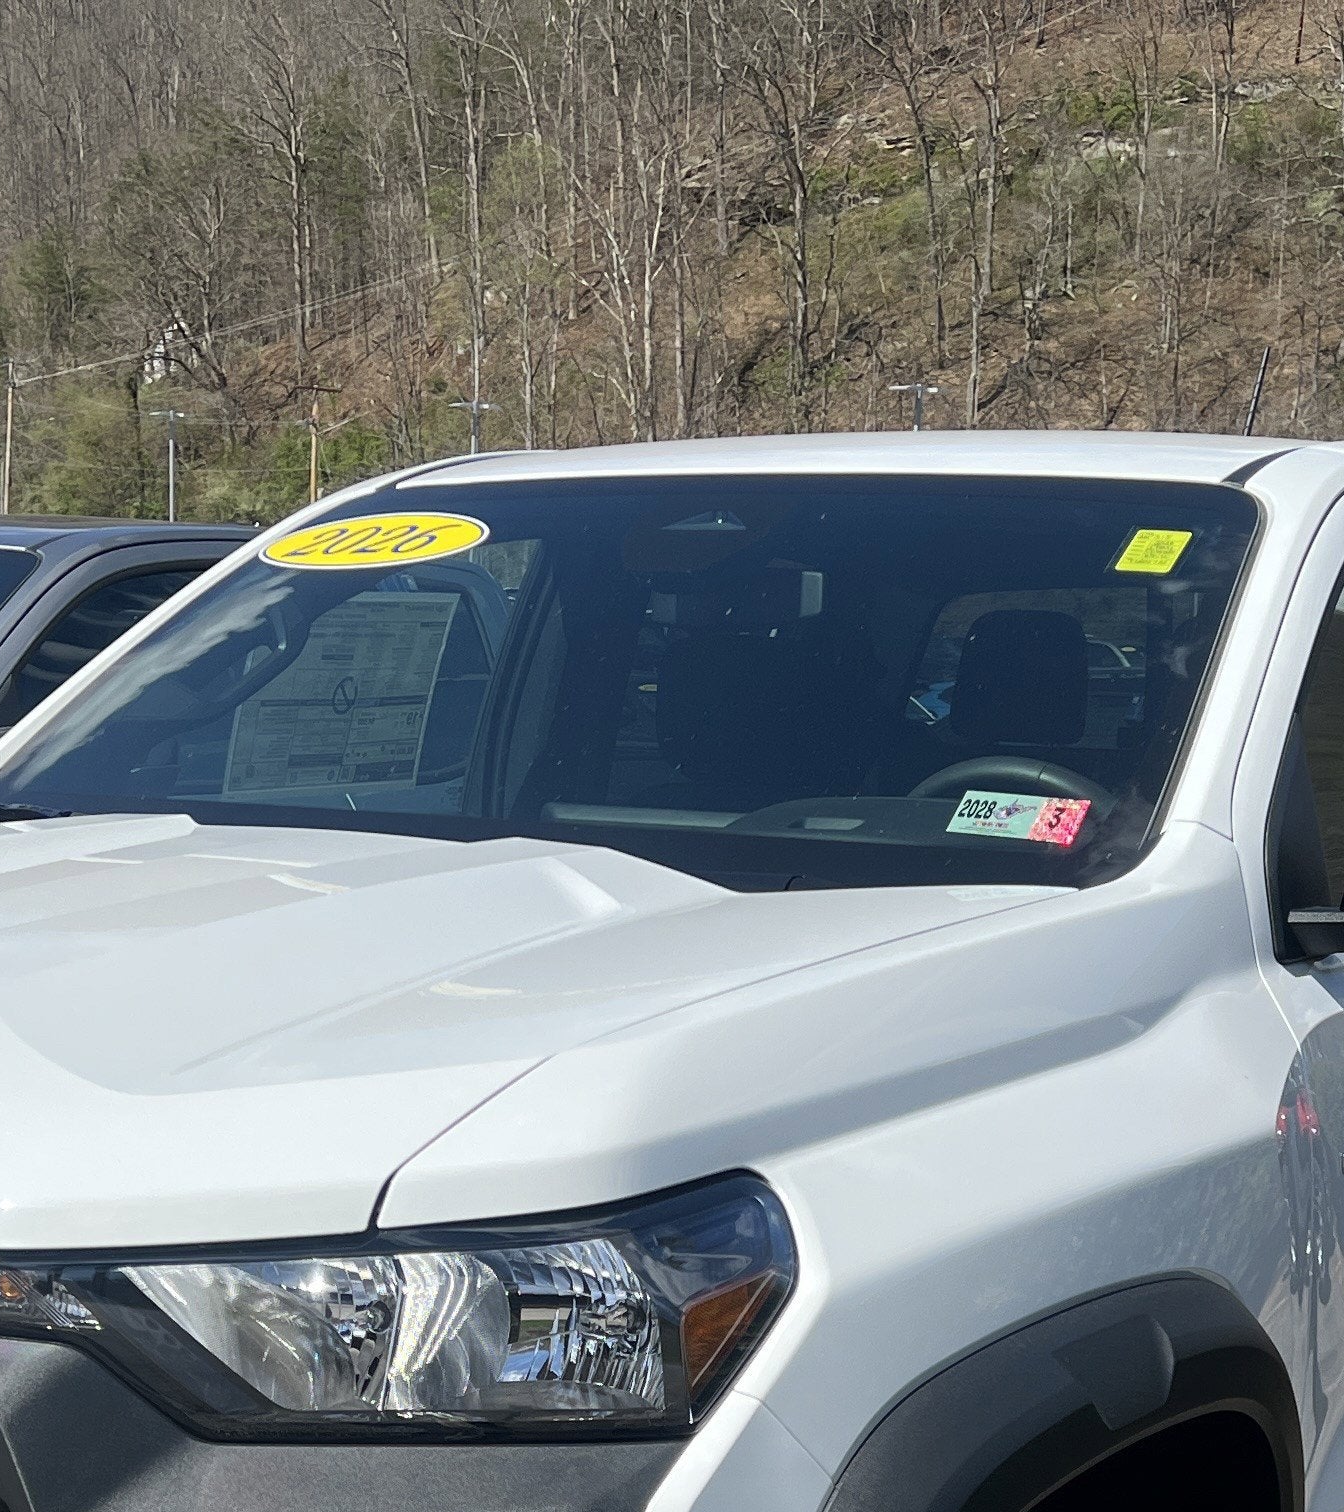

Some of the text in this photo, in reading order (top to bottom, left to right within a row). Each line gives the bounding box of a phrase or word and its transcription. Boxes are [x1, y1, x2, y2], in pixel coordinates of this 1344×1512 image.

[281, 525, 462, 558] 2026
[957, 799, 1066, 829] 2028 3
